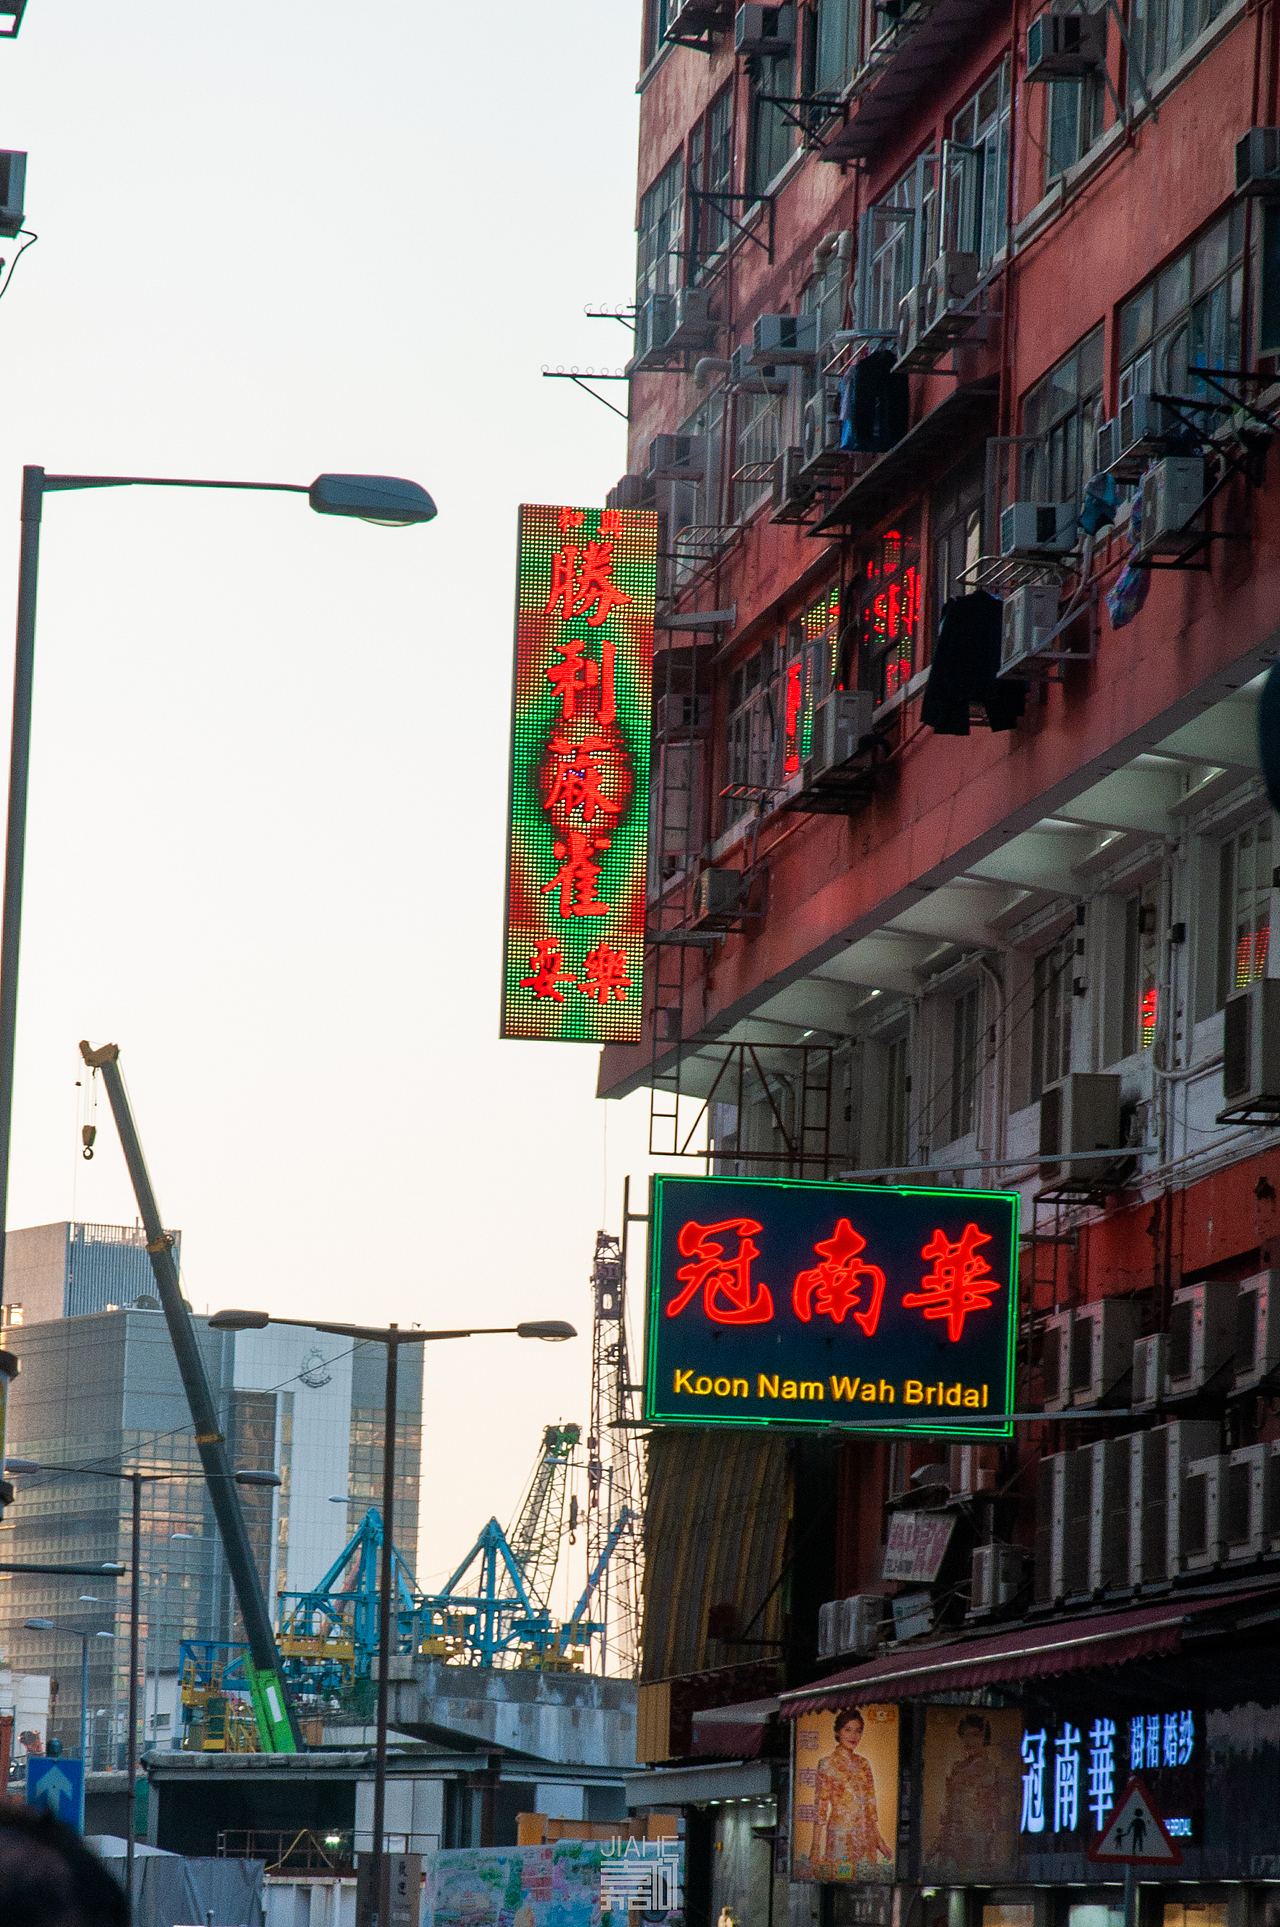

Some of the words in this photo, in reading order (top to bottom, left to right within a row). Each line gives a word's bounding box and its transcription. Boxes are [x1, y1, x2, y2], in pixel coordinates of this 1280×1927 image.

[665, 1217, 1001, 1342] 冠南華
[673, 1368, 749, 1398] Koon
[757, 1372, 824, 1400] Nam
[830, 1375, 895, 1403] Wah
[904, 1379, 989, 1408] Bridal
[1019, 1717, 1116, 1833] 冠南華
